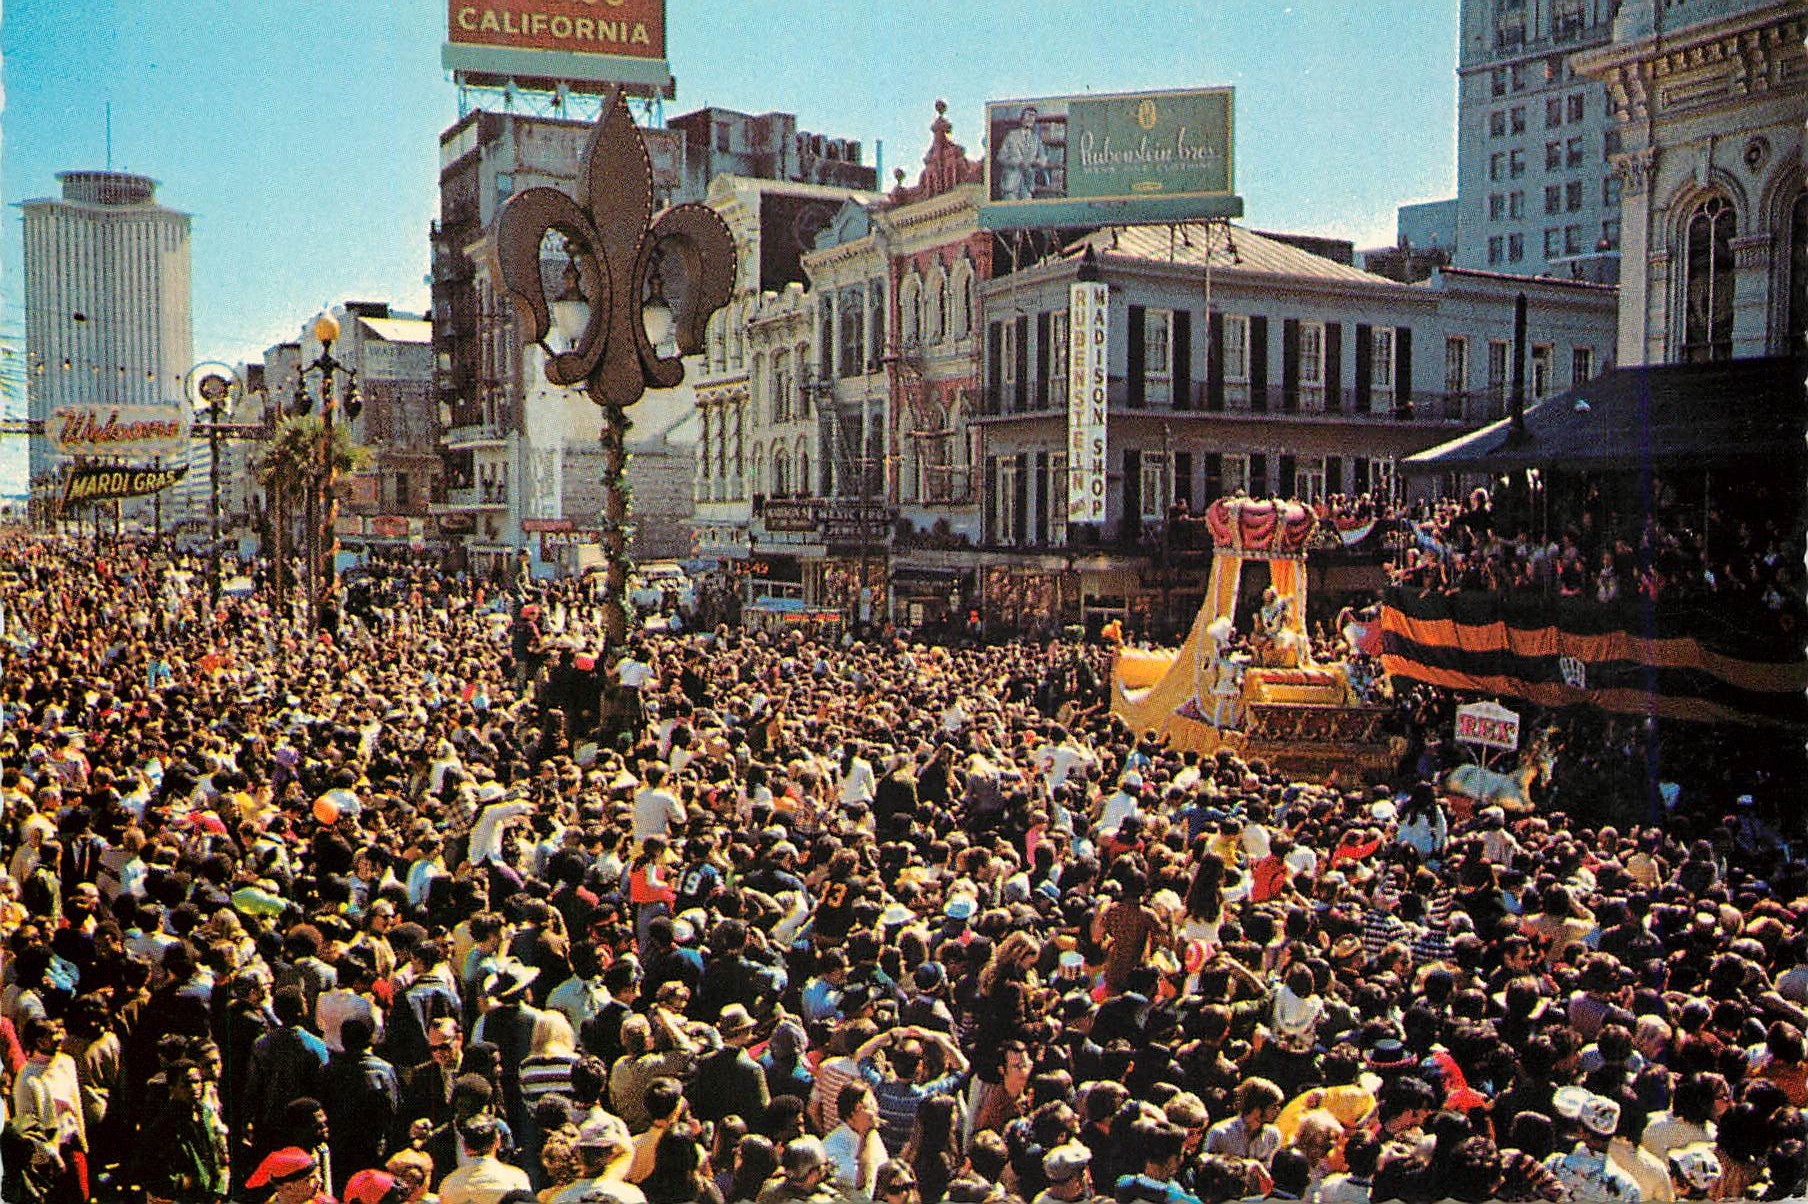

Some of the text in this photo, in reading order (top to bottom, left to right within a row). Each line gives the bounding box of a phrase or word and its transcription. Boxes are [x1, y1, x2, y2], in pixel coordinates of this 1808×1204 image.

[457, 7, 650, 45] CALIFORNIA
[1091, 288, 1106, 516] MADISON SHOP
[55, 408, 180, 444] Welcome
[69, 469, 177, 501] MARDI GRAS
[1459, 713, 1517, 743] REX
